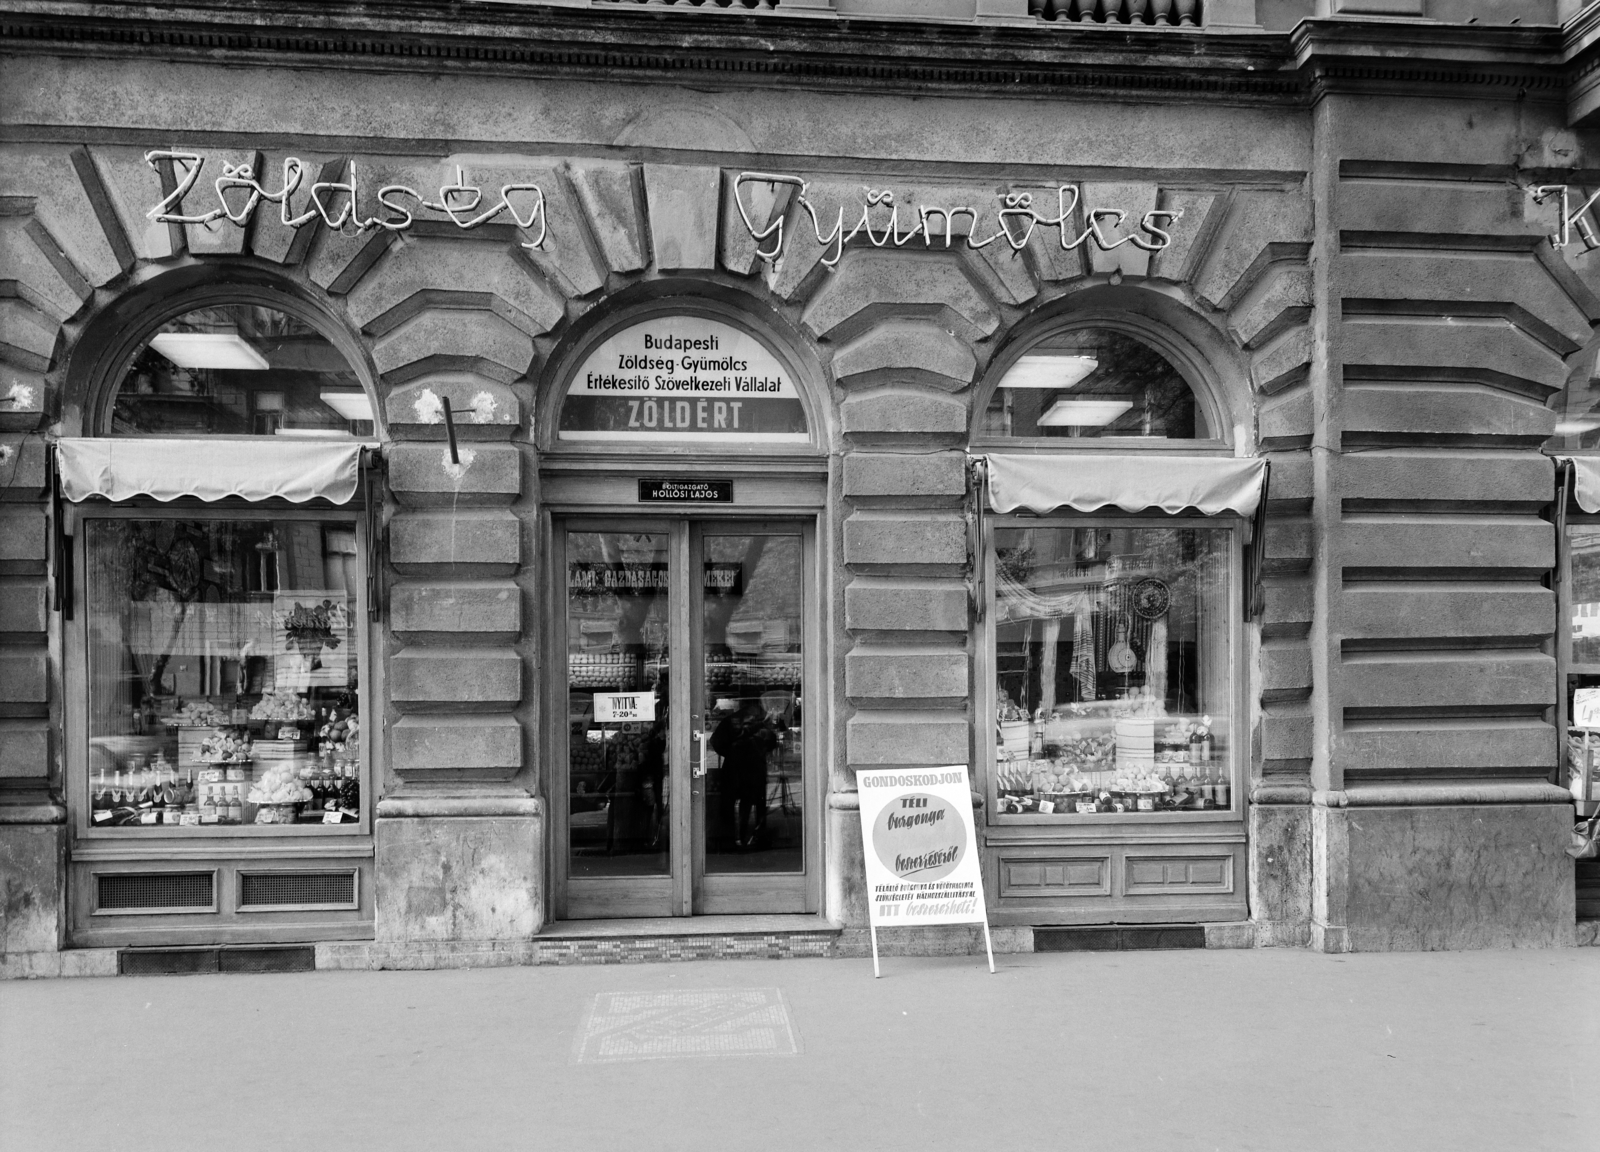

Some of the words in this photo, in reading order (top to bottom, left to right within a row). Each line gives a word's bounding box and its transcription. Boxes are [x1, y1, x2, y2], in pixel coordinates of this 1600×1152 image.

[145, 150, 547, 250] Zöldség
[734, 172, 1183, 266] Gyümölcs
[644, 334, 719, 353] Budapesti
[587, 371, 650, 390] Értékesítő
[654, 375, 731, 392] Szövetkezeti
[735, 377, 782, 393] Vállalat
[690, 490, 718, 499] LAJOS
[863, 772, 963, 788] GONDOSKODJON
[900, 796, 928, 809] TÉLI
[887, 808, 945, 831] burgonya
[879, 904, 901, 917] ITT
